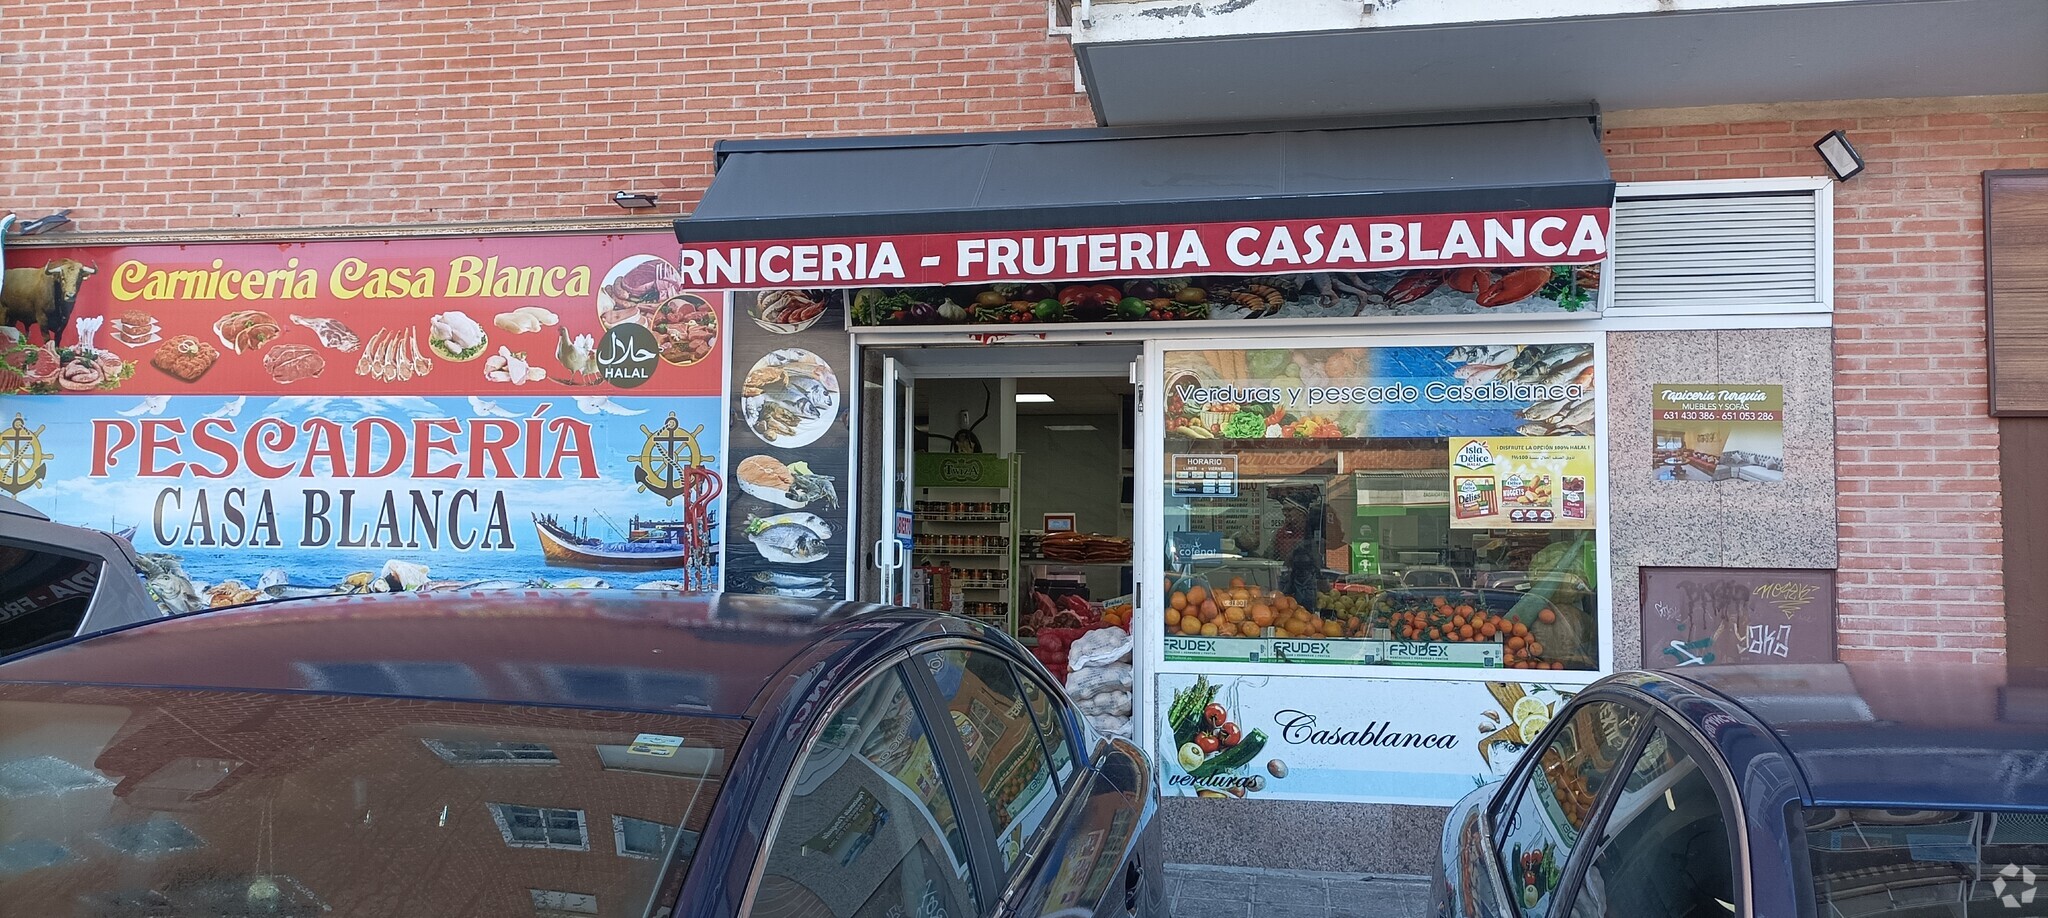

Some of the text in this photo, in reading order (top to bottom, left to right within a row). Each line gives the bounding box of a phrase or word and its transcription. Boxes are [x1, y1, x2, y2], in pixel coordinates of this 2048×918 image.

[957, 229, 1211, 277] FRUTERIA
[1225, 215, 1606, 266] CASABLANCA
[111, 255, 592, 301] Carniceria Casa Blanca
[598, 331, 657, 365] حلال
[605, 368, 649, 379] HALAL
[1176, 382, 1582, 408] Verduras y pescado Casablanca
[1682, 403, 1717, 411] MUEBLES
[1663, 411, 1679, 420] 631
[1681, 411, 1697, 420] 430
[1698, 411, 1715, 420] 386
[1721, 412, 1737, 420] 651
[1739, 412, 1756, 420] 053
[1757, 412, 1774, 421] 286
[90, 402, 600, 481] PESCADERÍA
[1459, 453, 1489, 463] Délice
[1465, 446, 1483, 455] Isla
[1502, 488, 1525, 497] NUGGETS
[154, 487, 515, 549] CASA BLANCA
[1274, 642, 1330, 654] FRUDEX
[1390, 644, 1449, 657] FRUDEX
[1274, 709, 1459, 750] Casablanca
[1168, 768, 1258, 789] verduras
